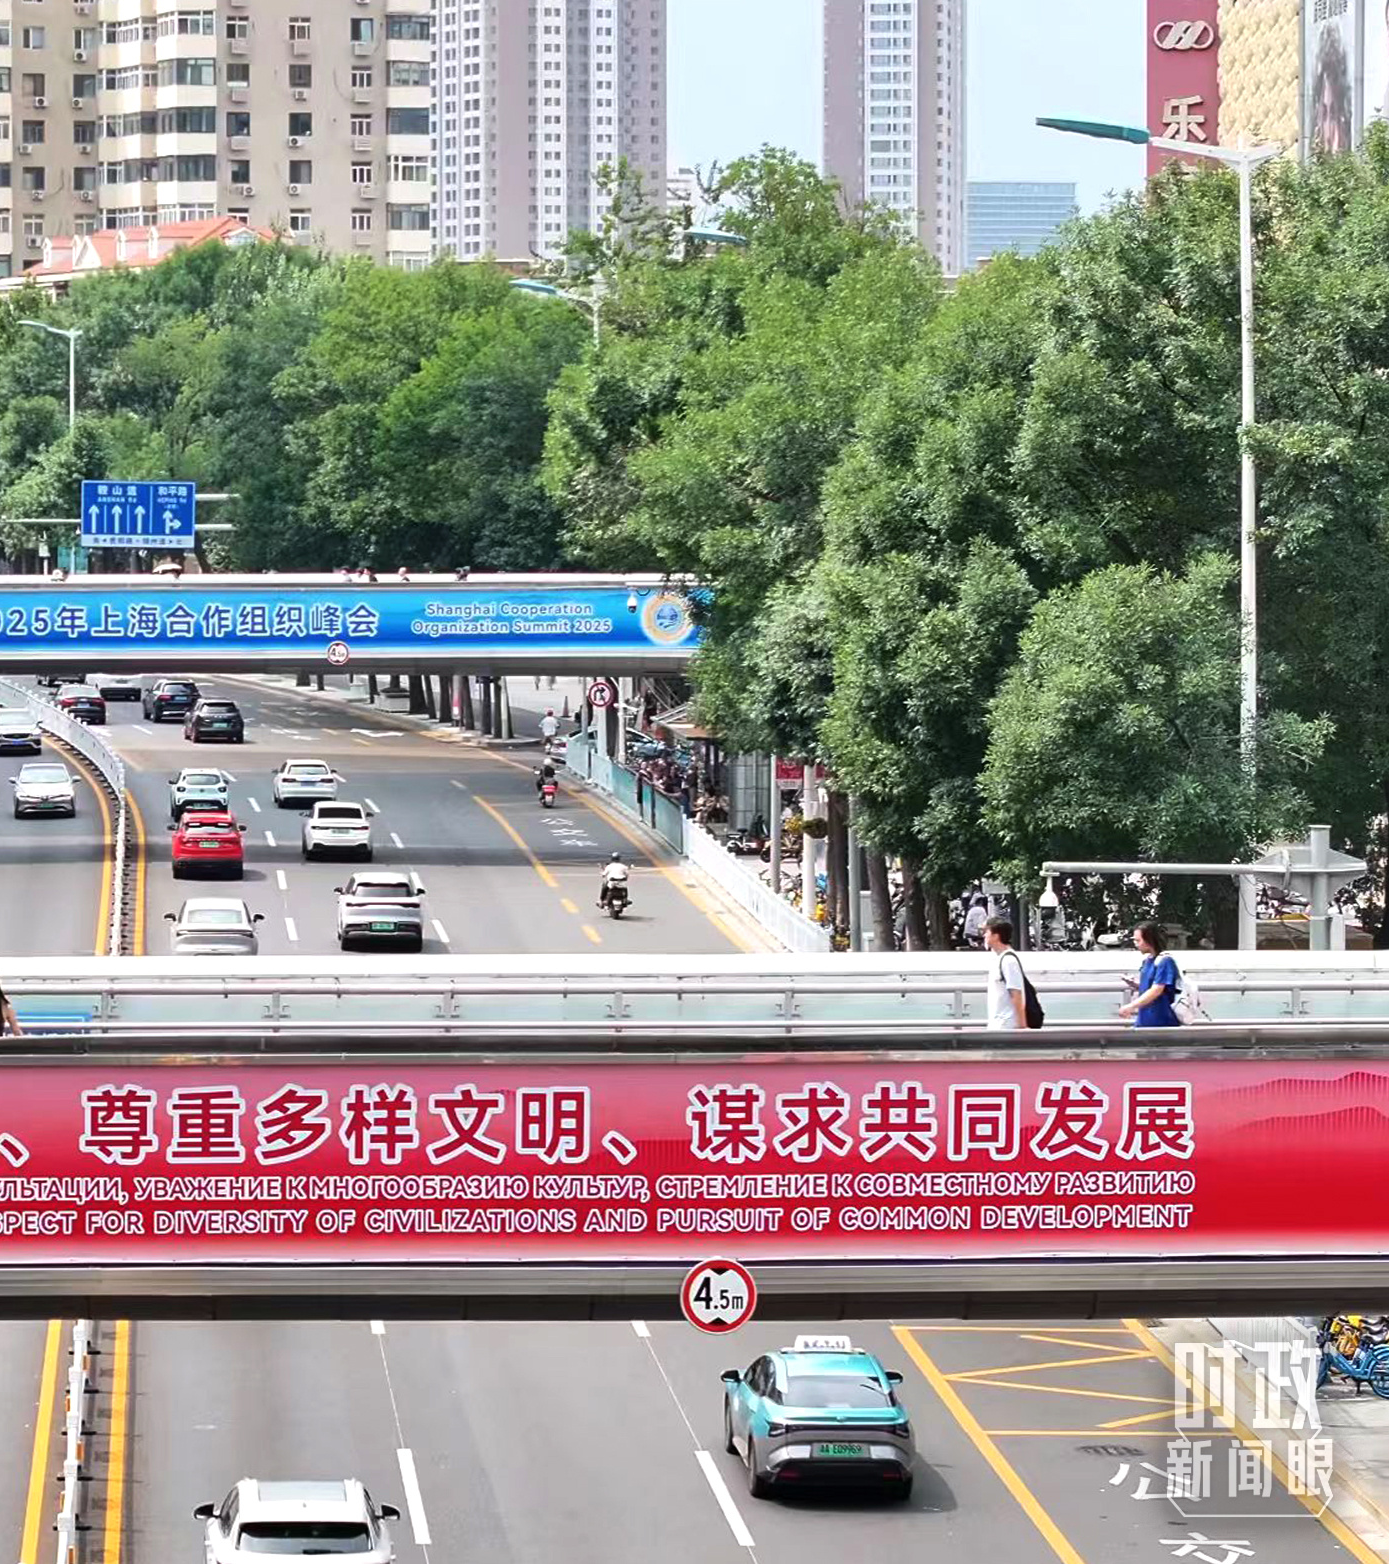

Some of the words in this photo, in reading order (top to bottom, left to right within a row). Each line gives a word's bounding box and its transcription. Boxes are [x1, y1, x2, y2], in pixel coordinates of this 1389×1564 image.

[1162, 94, 1207, 142] 乐
[157, 485, 188, 497] 和平路
[425, 603, 496, 619] Shanghai
[500, 603, 594, 618] Cooperation
[411, 620, 510, 637] Organization
[512, 620, 569, 634] Summit
[573, 619, 612, 634] 2025
[134, 1175, 282, 1201] УВАЖЕНИЕ
[286, 1175, 308, 1200] К
[309, 1174, 530, 1200] МНОГООБРАЗИЮ
[533, 1174, 650, 1204] КУЛЬТУР,
[656, 1173, 827, 1199] СТРЕМЛЕНИЕ
[831, 1173, 853, 1198] К
[854, 1172, 1052, 1198] СОВМЕСТНОМУ
[1054, 1170, 1196, 1196] РАЗВИТИЮ
[85, 1209, 144, 1236] FOR
[154, 1209, 307, 1235] DIVERSITY
[315, 1208, 356, 1234] OF
[364, 1208, 576, 1234] CIVILIZATIONS
[584, 1207, 648, 1233] AND
[656, 1206, 785, 1232] PURSUIT
[790, 1206, 830, 1232] OF
[838, 1205, 971, 1231] COMMON
[981, 1204, 1193, 1230] DEVELOPMENT
[693, 1276, 744, 1310] 4.5m
